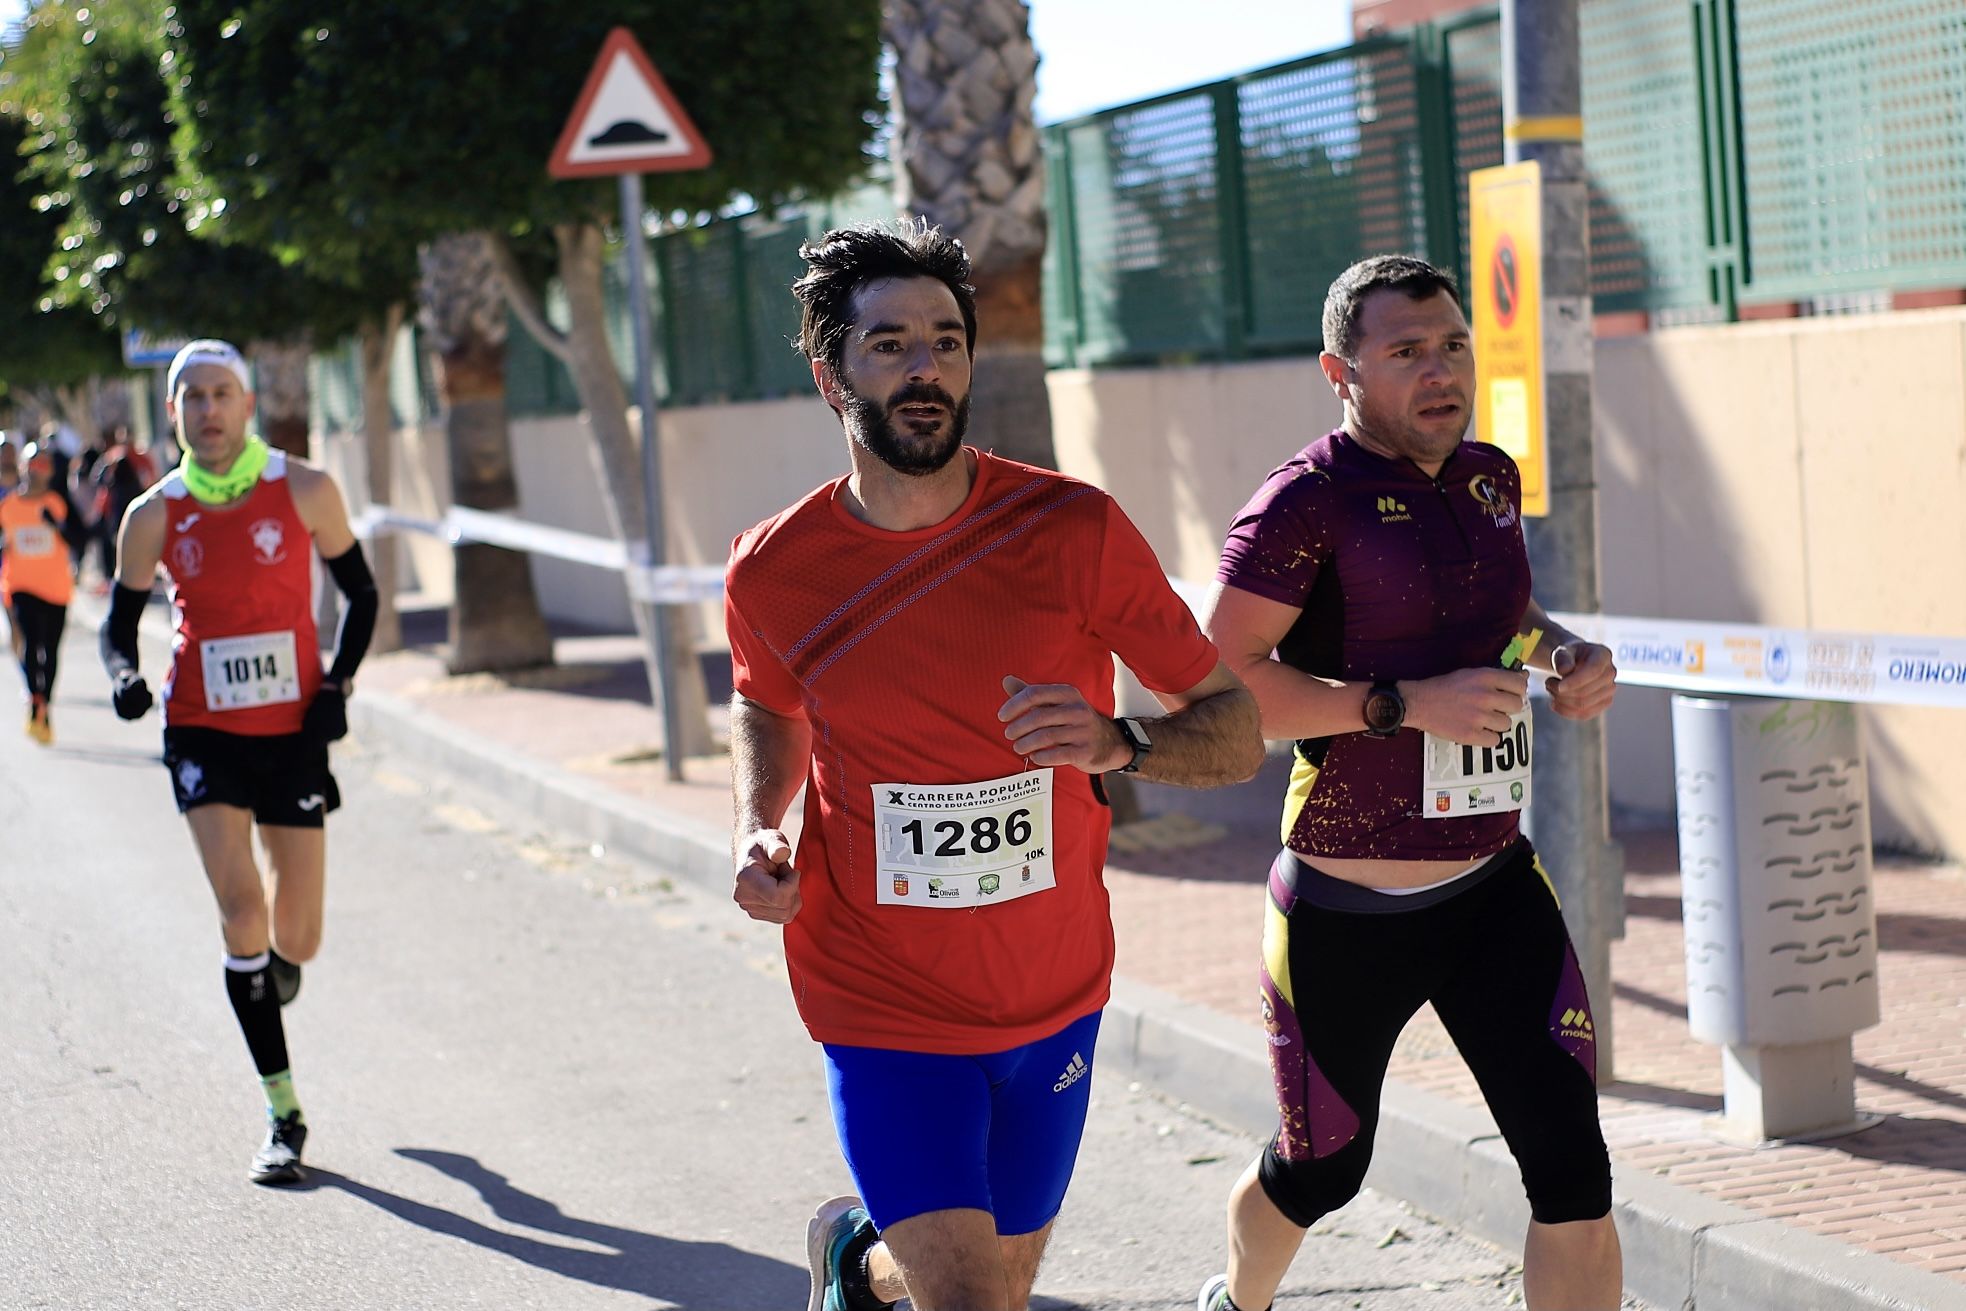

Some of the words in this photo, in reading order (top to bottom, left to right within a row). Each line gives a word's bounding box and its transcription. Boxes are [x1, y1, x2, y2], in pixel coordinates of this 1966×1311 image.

[1617, 643, 1683, 667] ROMERO
[223, 653, 277, 685] 1014
[907, 791, 974, 802] CARRERA
[979, 777, 1040, 798] POPULAR
[944, 799, 995, 809] EDUCATIVO
[901, 808, 1032, 857] 1286
[1024, 847, 1045, 861] 10K
[1053, 1064, 1088, 1092] adidas
